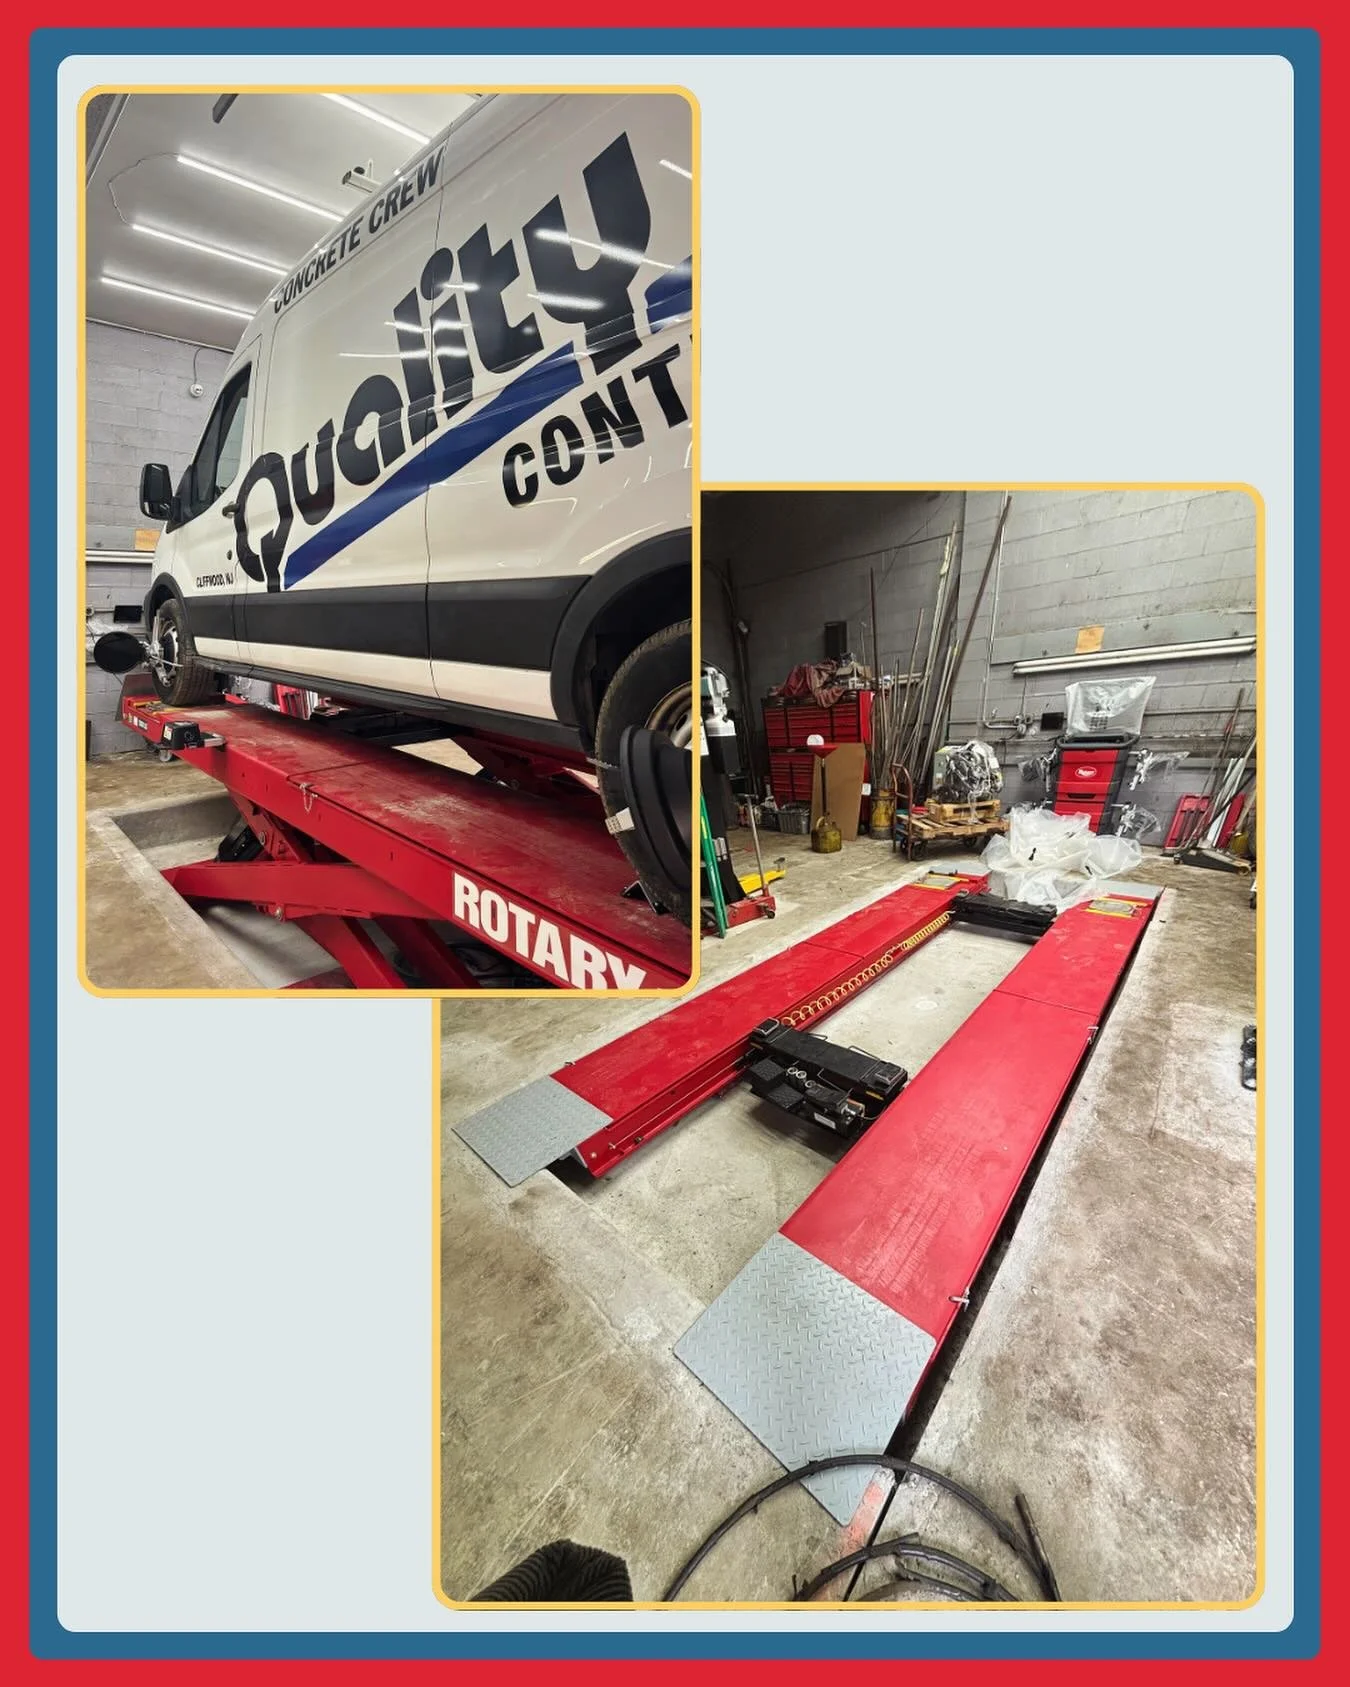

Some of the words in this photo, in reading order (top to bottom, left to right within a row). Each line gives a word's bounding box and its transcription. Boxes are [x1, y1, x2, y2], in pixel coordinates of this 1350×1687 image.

[273, 215, 365, 314] CONCRETE
[368, 145, 446, 234] CREW
[234, 131, 652, 593] Quality
[502, 334, 692, 508] CONT
[454, 872, 647, 989] ROTARY
